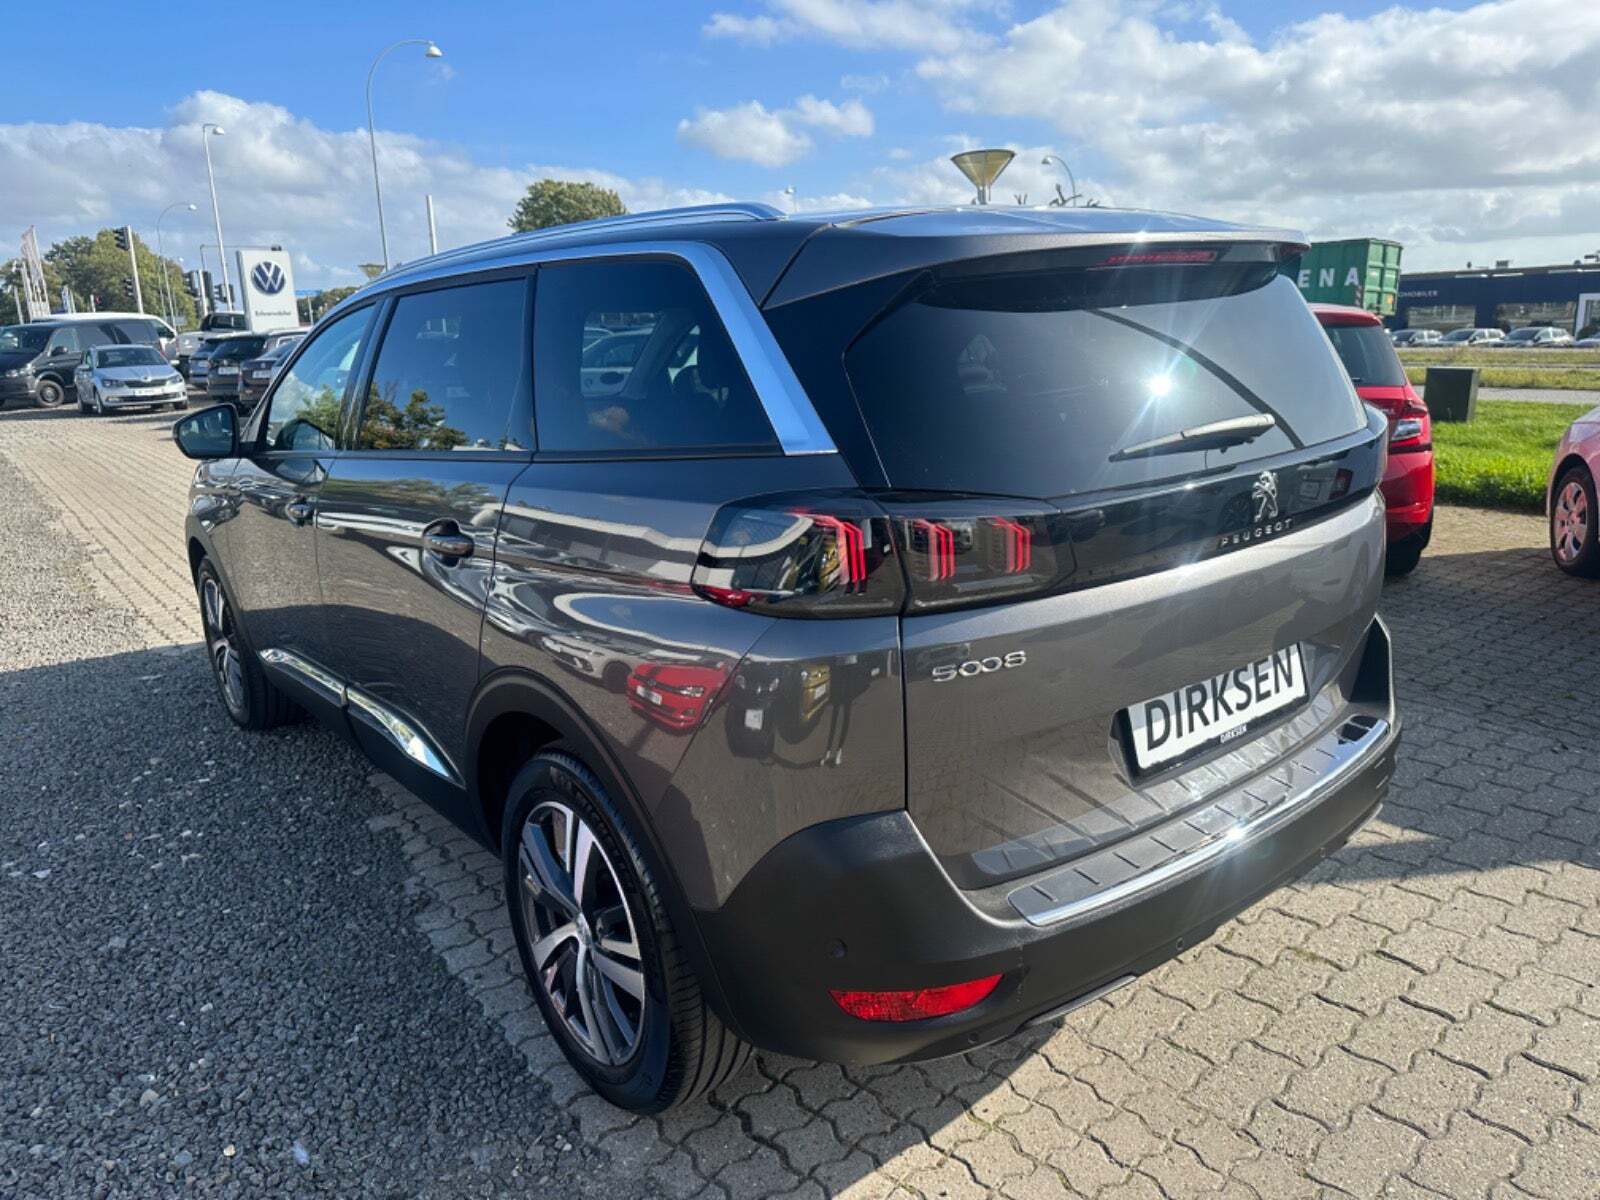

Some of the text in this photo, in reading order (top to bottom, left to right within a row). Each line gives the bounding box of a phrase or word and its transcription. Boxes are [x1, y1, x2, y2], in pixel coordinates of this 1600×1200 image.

[1221, 518, 1292, 546] PEUGEOT
[931, 650, 1026, 682] 5008
[1144, 648, 1294, 751] DIRKSEN
